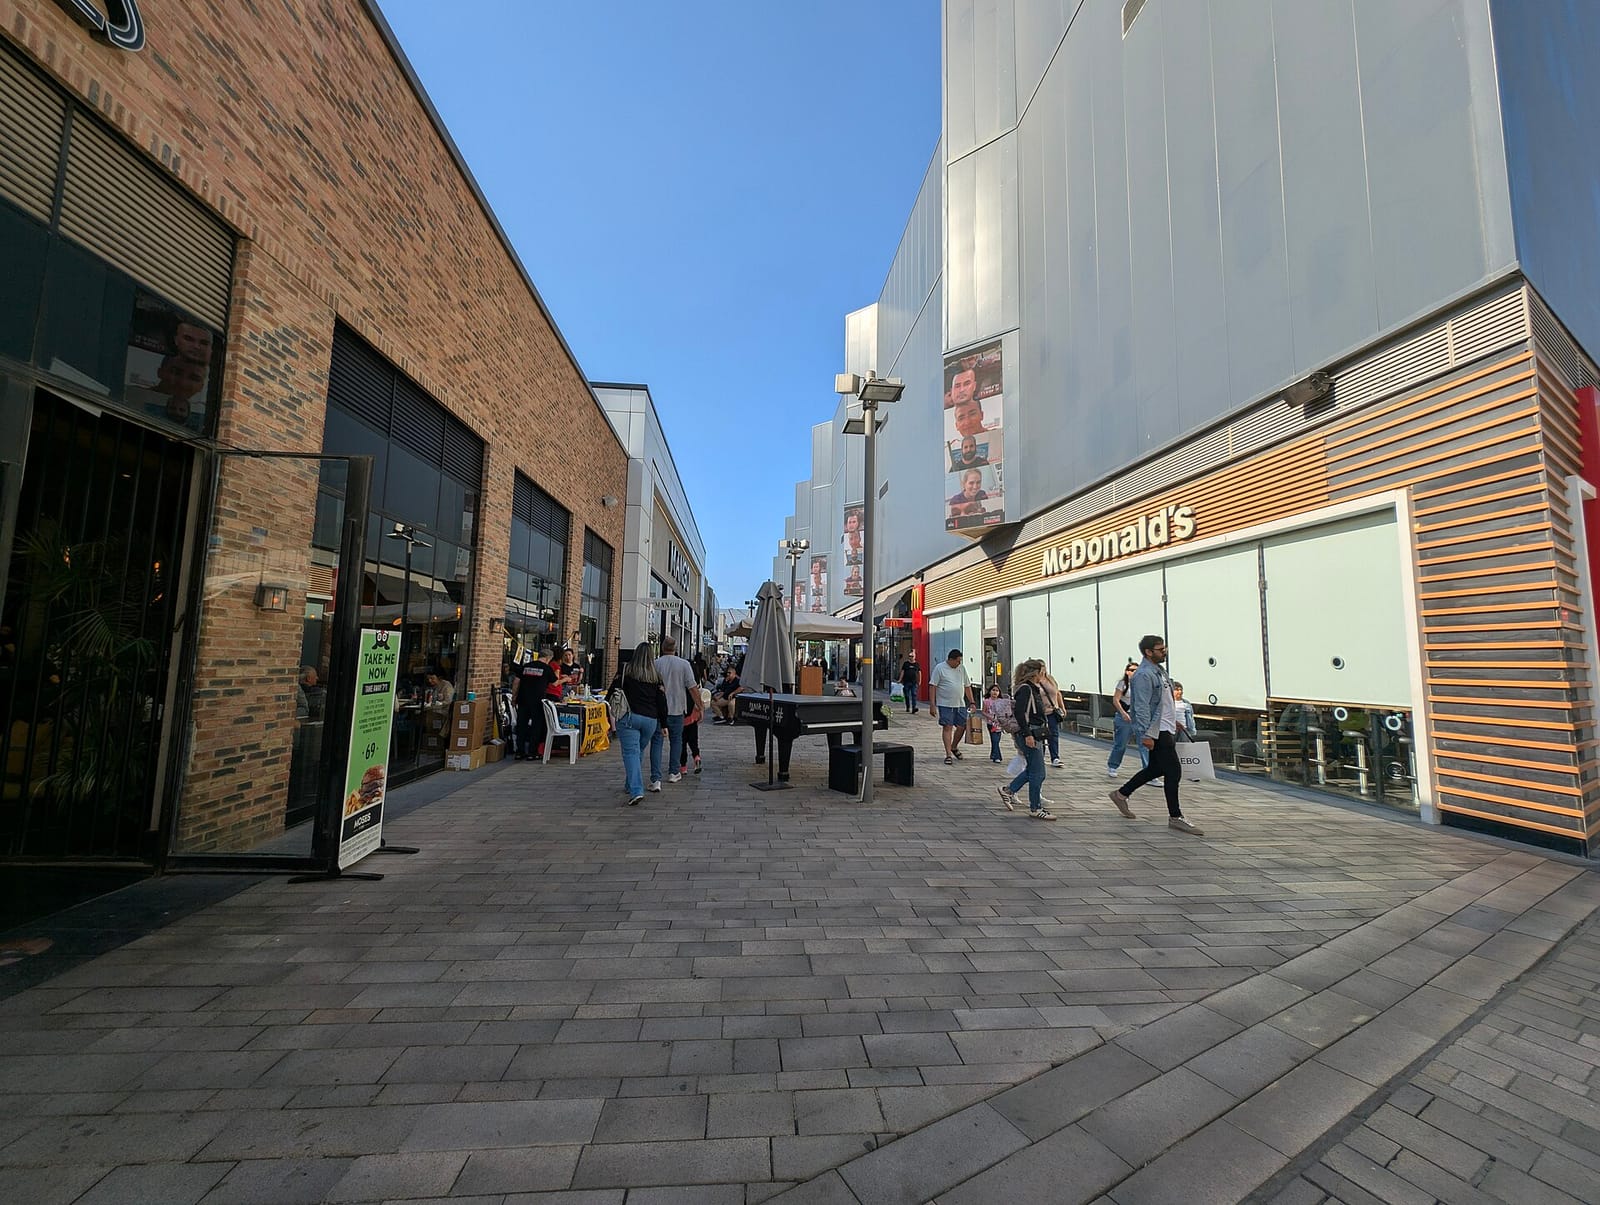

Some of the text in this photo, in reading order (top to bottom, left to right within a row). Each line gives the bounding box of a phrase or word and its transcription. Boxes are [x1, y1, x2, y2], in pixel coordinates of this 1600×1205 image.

[1042, 504, 1197, 576] McDonald's
[364, 653, 396, 665] TAKE ME
[368, 667, 388, 679] NOW
[365, 742, 376, 761] 69
[1180, 757, 1201, 765] EBO
